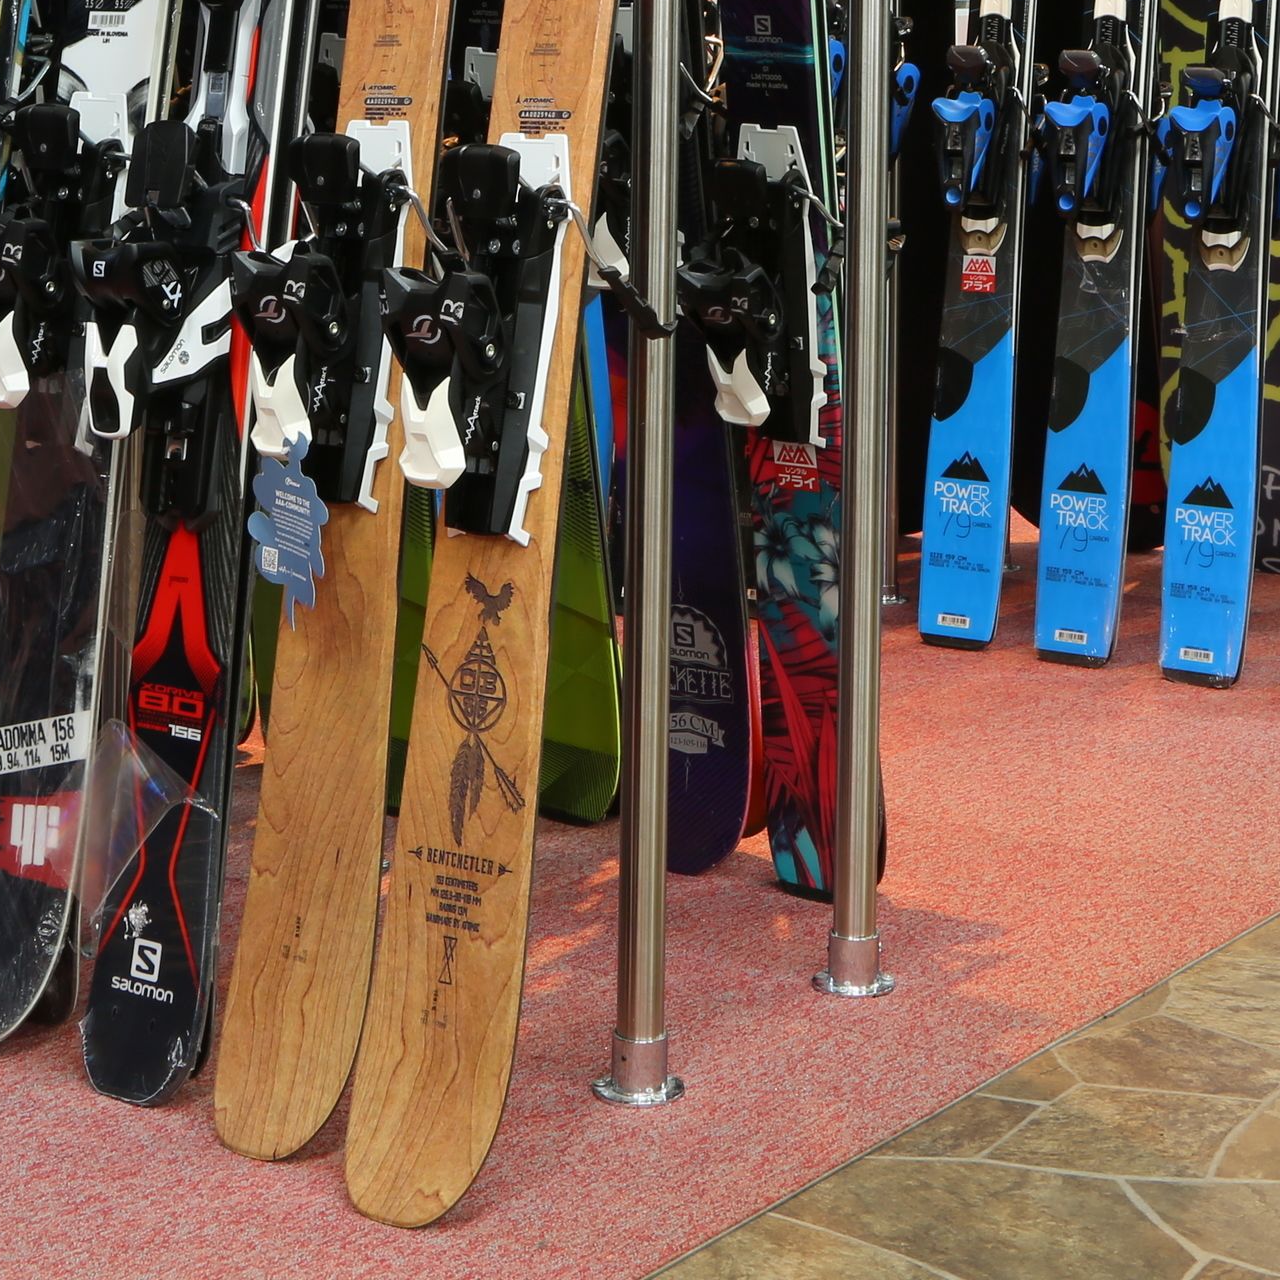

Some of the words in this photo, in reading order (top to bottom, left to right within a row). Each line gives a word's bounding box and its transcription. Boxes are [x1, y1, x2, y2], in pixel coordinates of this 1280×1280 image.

[963, 281, 993, 291] アライ
[159, 338, 186, 375] salomon
[778, 473, 816, 489] アライ
[933, 481, 990, 501] POWER
[939, 497, 992, 518] TRACK
[1050, 493, 1108, 514] POWER
[1056, 510, 1109, 531] TRACK
[1175, 508, 1234, 529] POWER
[1181, 524, 1236, 547] TRACK
[52, 717, 75, 741] 158
[168, 723, 202, 742] 156
[690, 715, 715, 734] CM
[50, 741, 70, 761] 15M
[111, 975, 174, 1004] salomon
